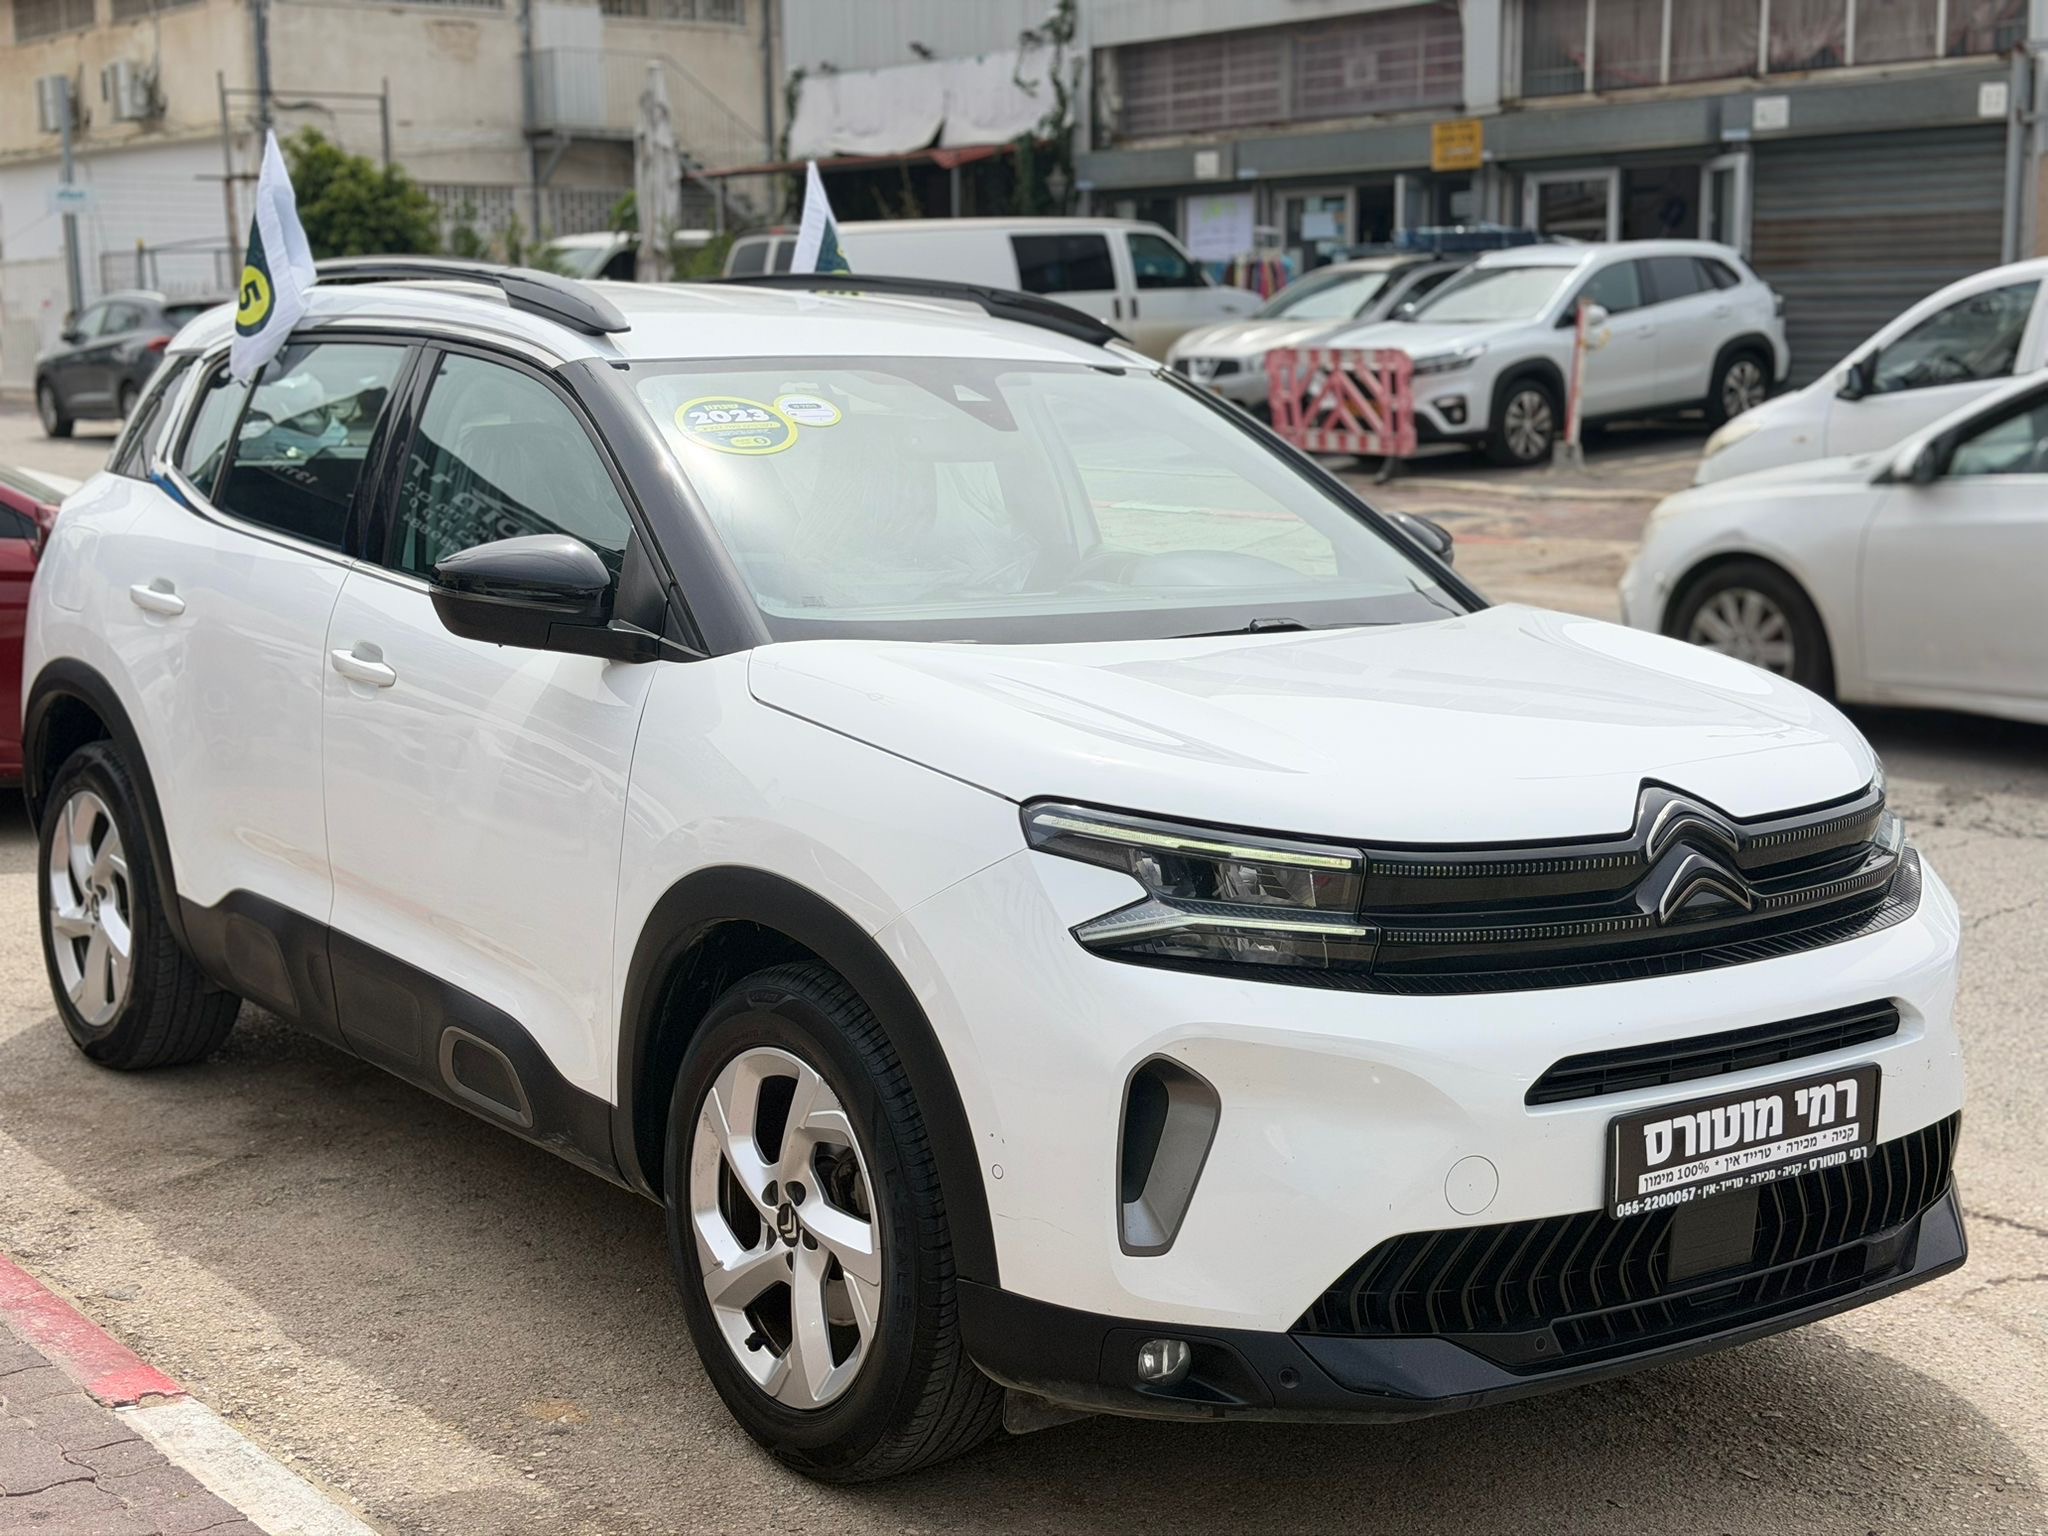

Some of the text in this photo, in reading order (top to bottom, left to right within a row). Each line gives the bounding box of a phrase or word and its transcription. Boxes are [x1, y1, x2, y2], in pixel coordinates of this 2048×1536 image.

[689, 409, 769, 424] 2023
[1643, 1078, 1858, 1166] רמי מוטורס
[1616, 1146, 1868, 1218] רמי מוטורס קניה מכירה טרייד-אין 055-2200057
[1643, 1127, 1855, 1192] קניה מכירה טרייד אין 100% מימון
